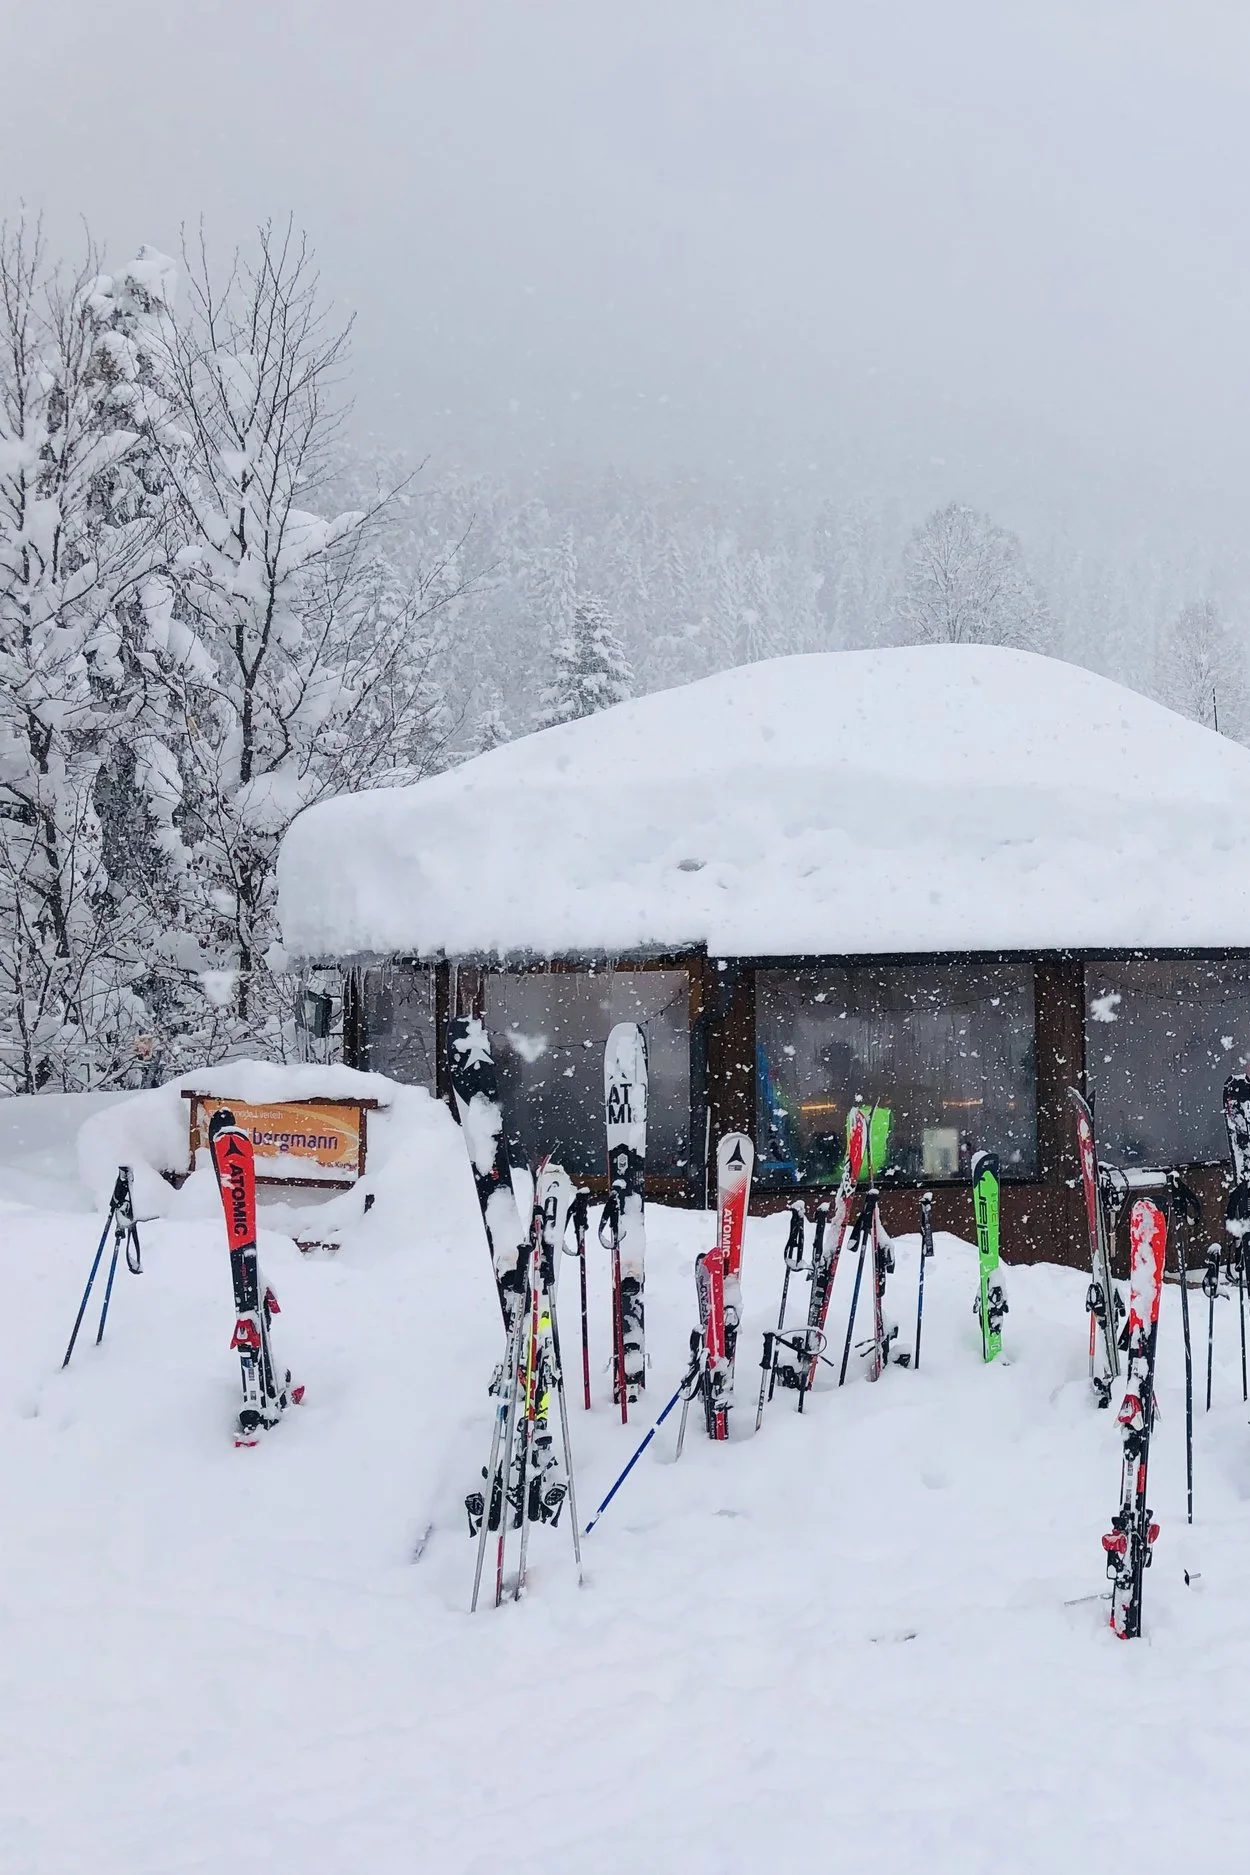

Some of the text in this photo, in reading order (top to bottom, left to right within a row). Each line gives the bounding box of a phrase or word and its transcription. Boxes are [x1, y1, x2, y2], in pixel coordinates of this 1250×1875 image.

[252, 1127, 338, 1152] bergmann
[230, 1163, 248, 1236] ATOMIC
[722, 1208, 733, 1258] ATOMIC
